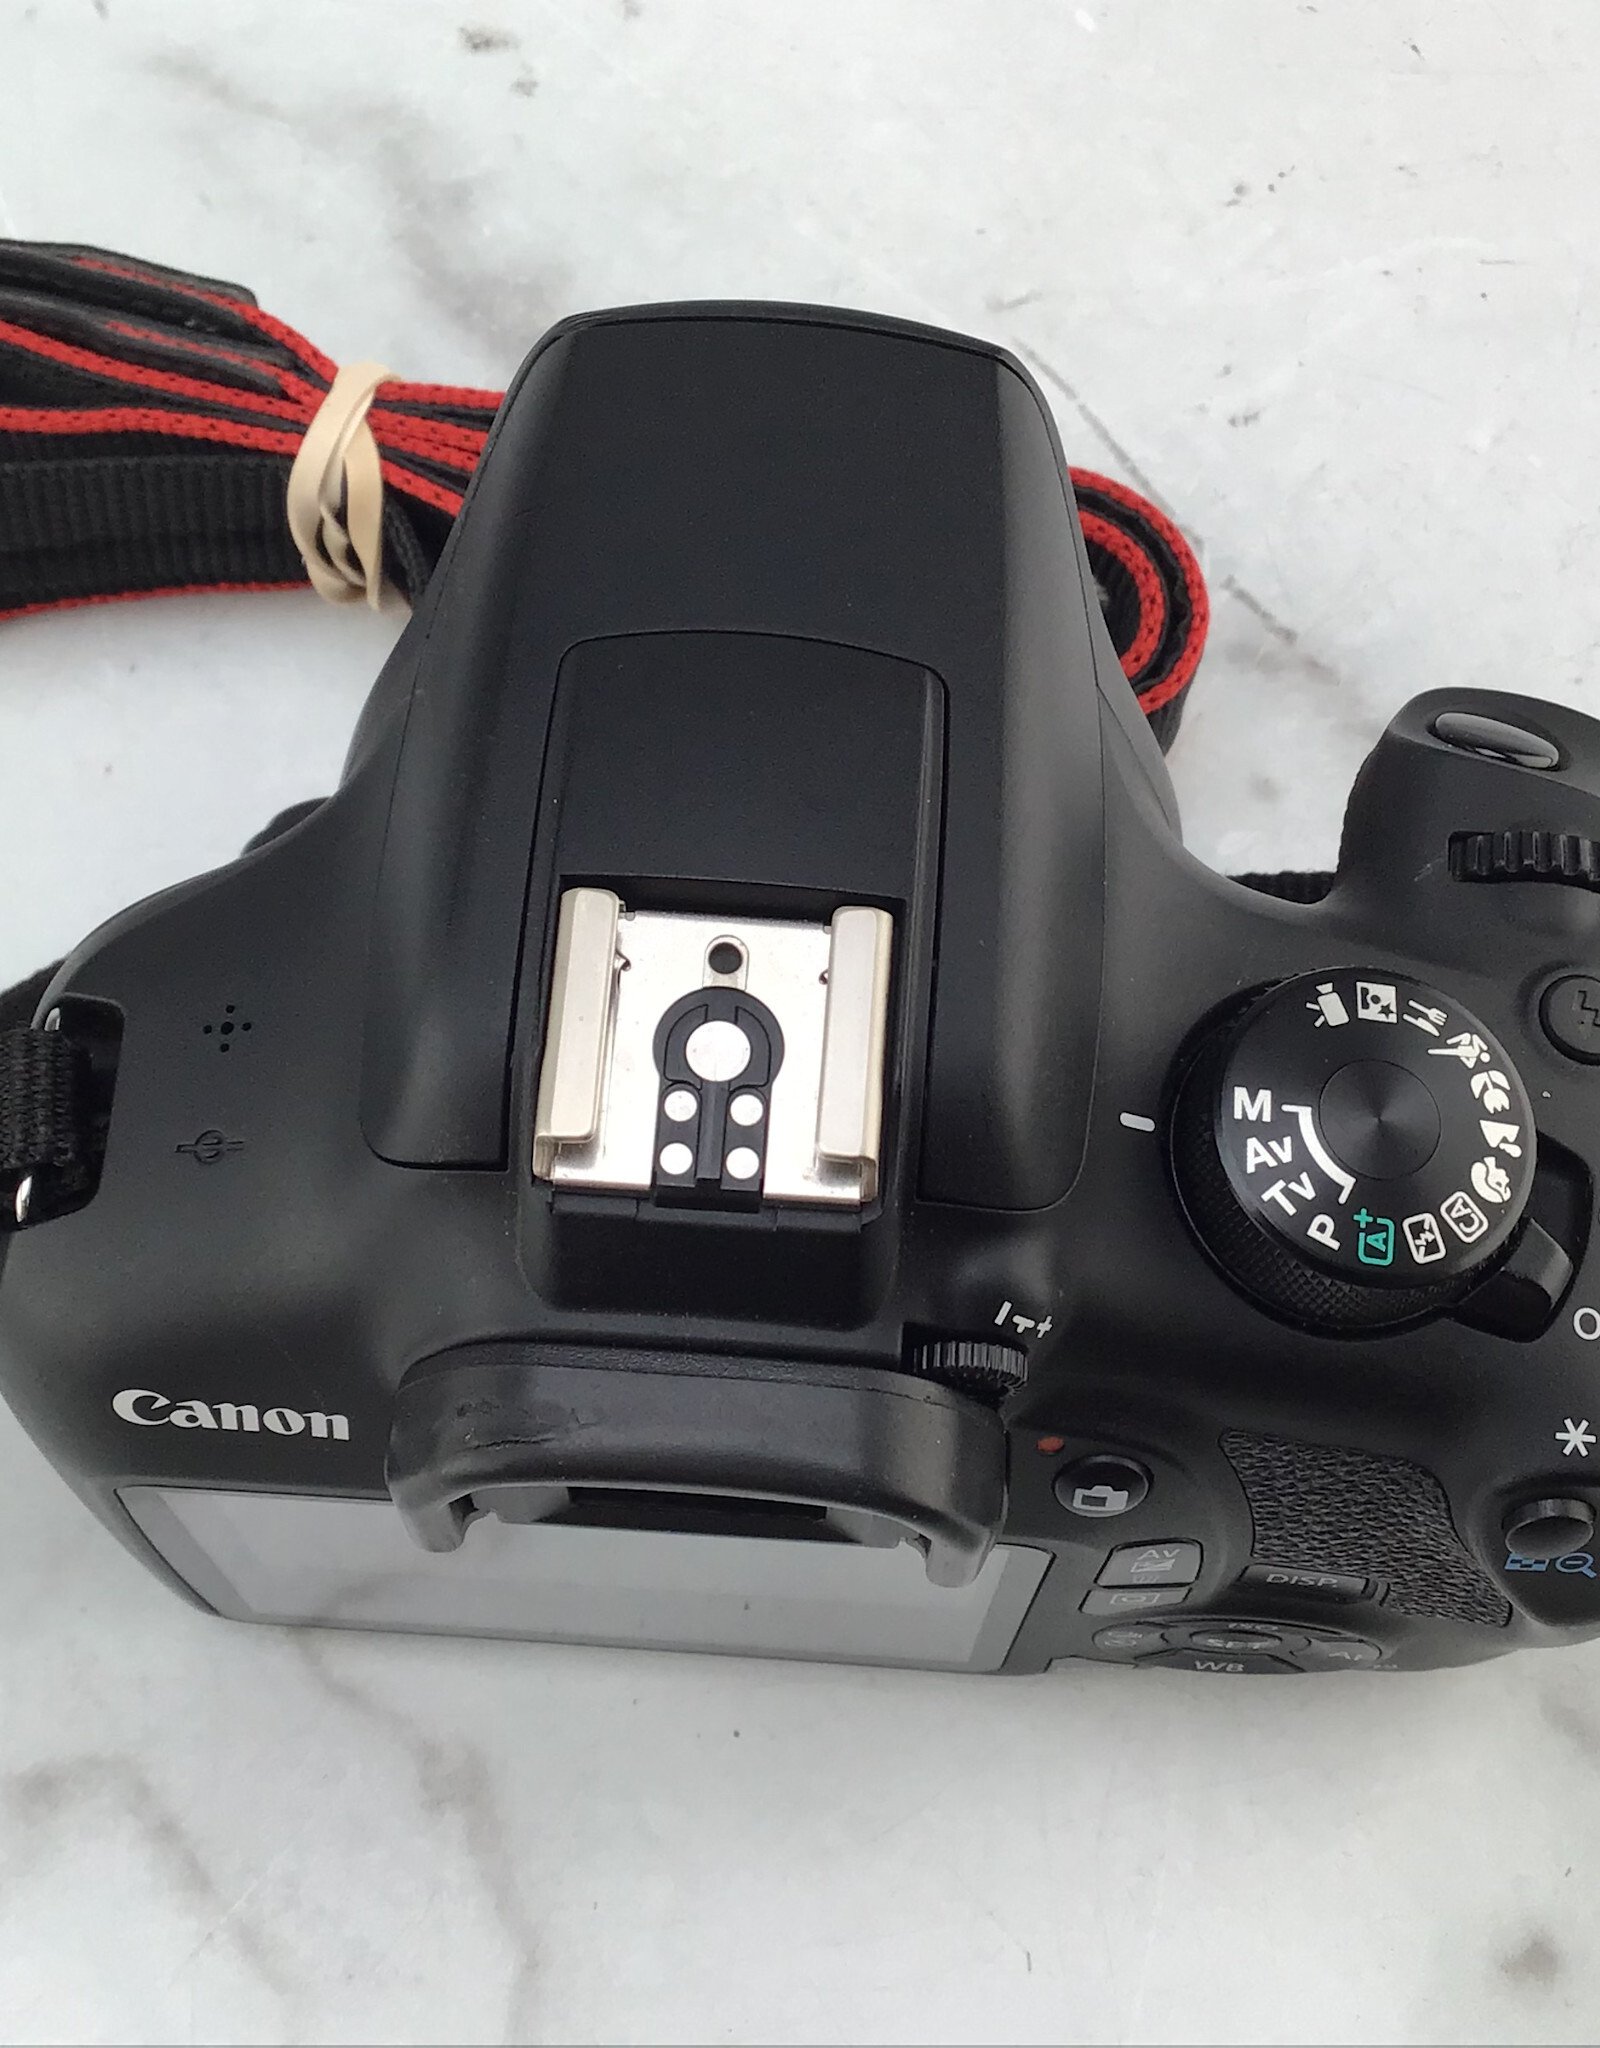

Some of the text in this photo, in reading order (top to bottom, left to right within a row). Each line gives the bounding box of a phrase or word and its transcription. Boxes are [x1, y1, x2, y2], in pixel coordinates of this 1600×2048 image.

[1234, 1086, 1272, 1122] M
[1246, 1136, 1292, 1174] Av
[1261, 1172, 1317, 1216] Tv
[1306, 1214, 1341, 1251] P
[112, 1389, 350, 1441] Canon
[1194, 1660, 1245, 1673] WB
